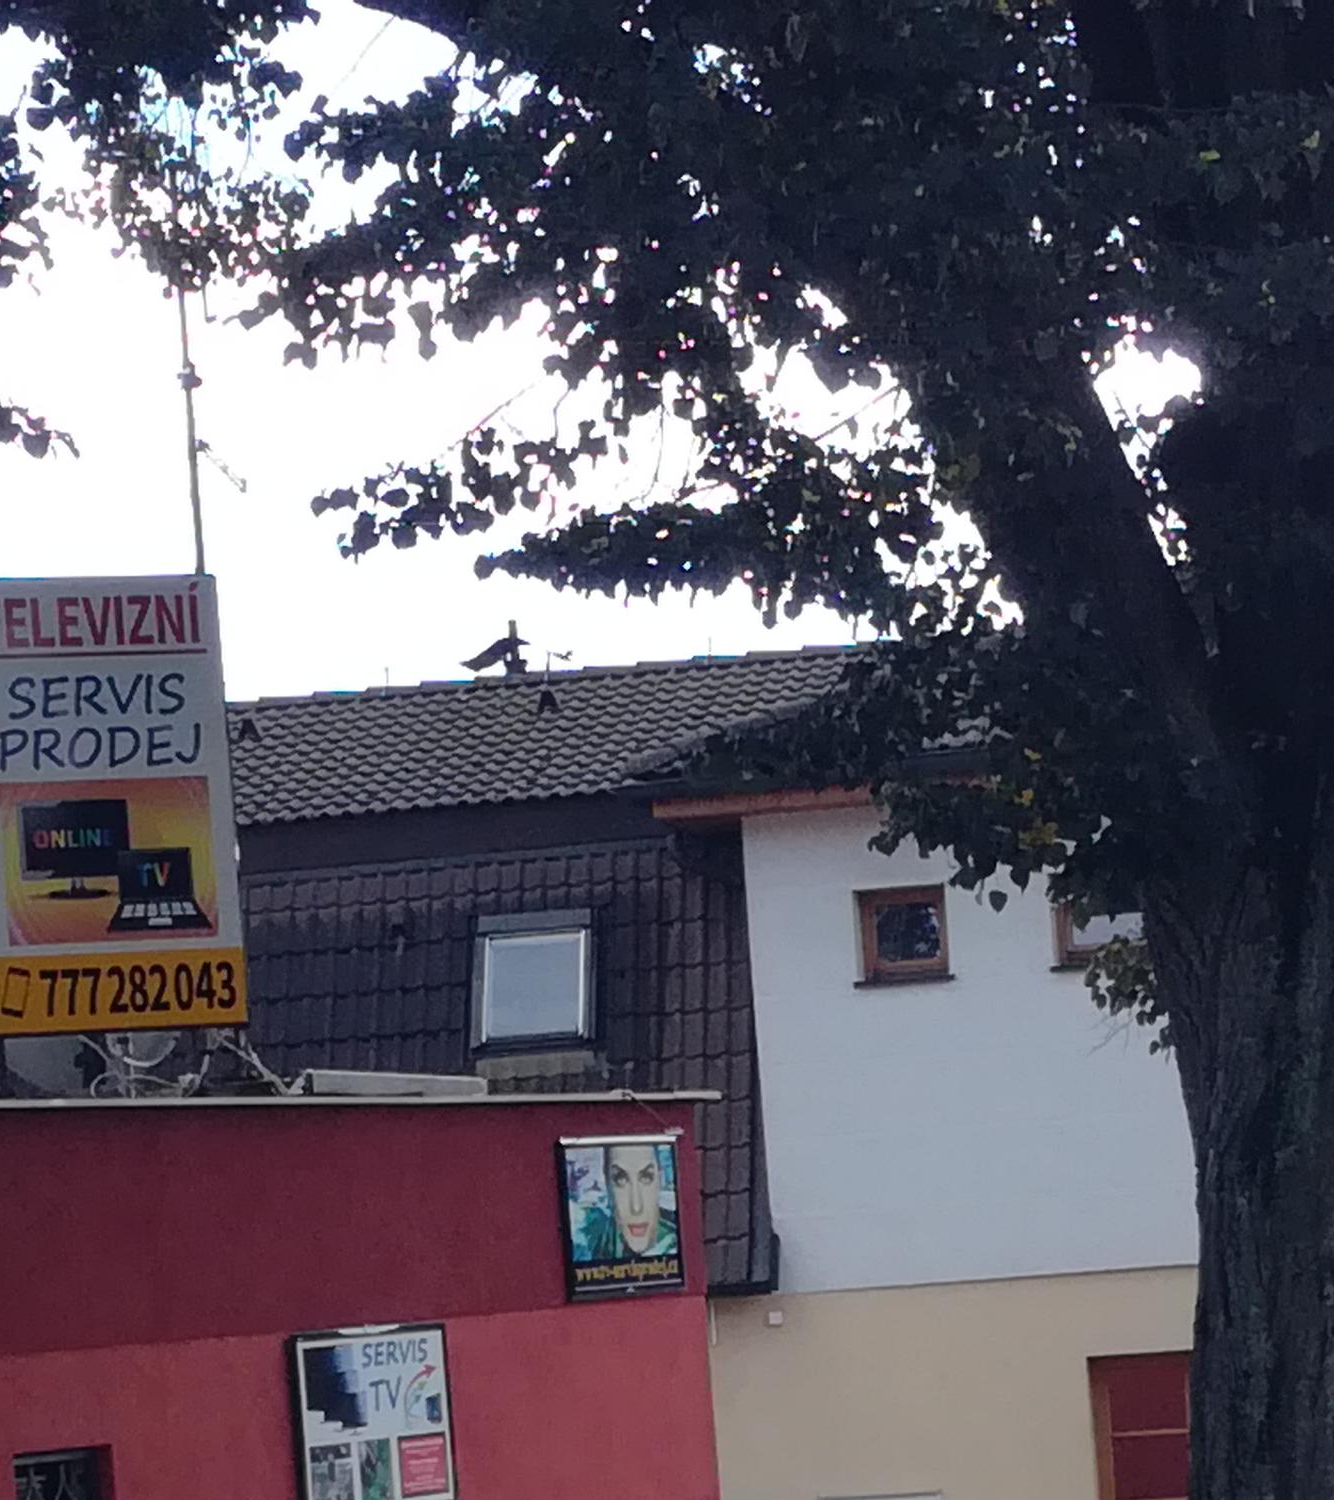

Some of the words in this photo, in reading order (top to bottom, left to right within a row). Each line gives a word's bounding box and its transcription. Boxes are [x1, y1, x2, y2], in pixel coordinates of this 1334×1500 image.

[8, 673, 186, 720] SERVIS
[0, 722, 201, 772] PRODEJ
[33, 828, 113, 850] ONLINE
[138, 861, 171, 888] TV
[361, 1338, 429, 1368] SERVIS
[368, 1376, 403, 1412] TV
